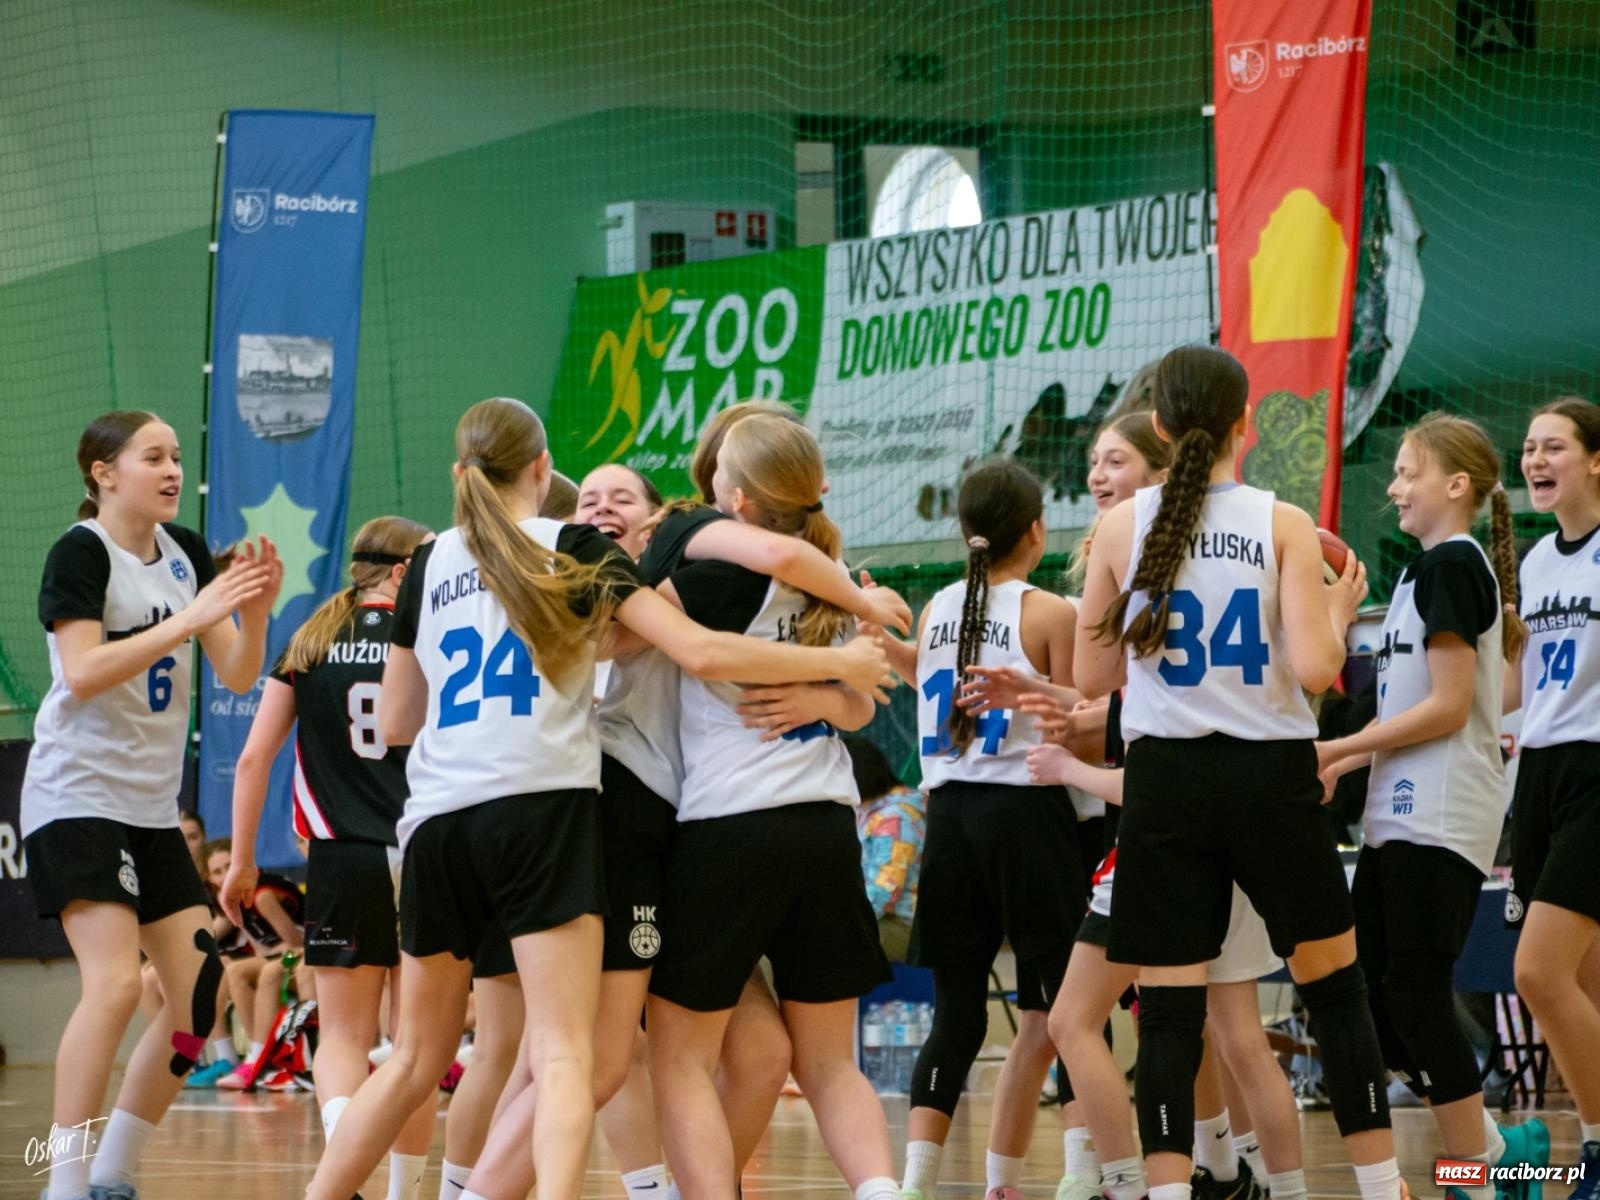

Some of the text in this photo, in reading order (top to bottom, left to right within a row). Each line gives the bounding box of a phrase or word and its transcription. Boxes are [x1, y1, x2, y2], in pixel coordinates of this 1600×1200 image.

[1275, 35, 1365, 61] Racibórz
[275, 194, 358, 213] Racibórz
[847, 221, 1010, 305] WSZYSTKO
[1021, 211, 1081, 280] DLA
[662, 287, 799, 372] ZOO
[838, 282, 1111, 380] DOMOWEGO ZOO
[1187, 532, 1265, 570] YŁUSKA
[929, 620, 1010, 651] ZALSKA
[1152, 588, 1269, 687] 34
[1528, 612, 1588, 634] WARSAW
[147, 656, 176, 713] 6
[437, 625, 540, 730] 24
[347, 682, 388, 761] 8
[632, 905, 657, 922] HK
